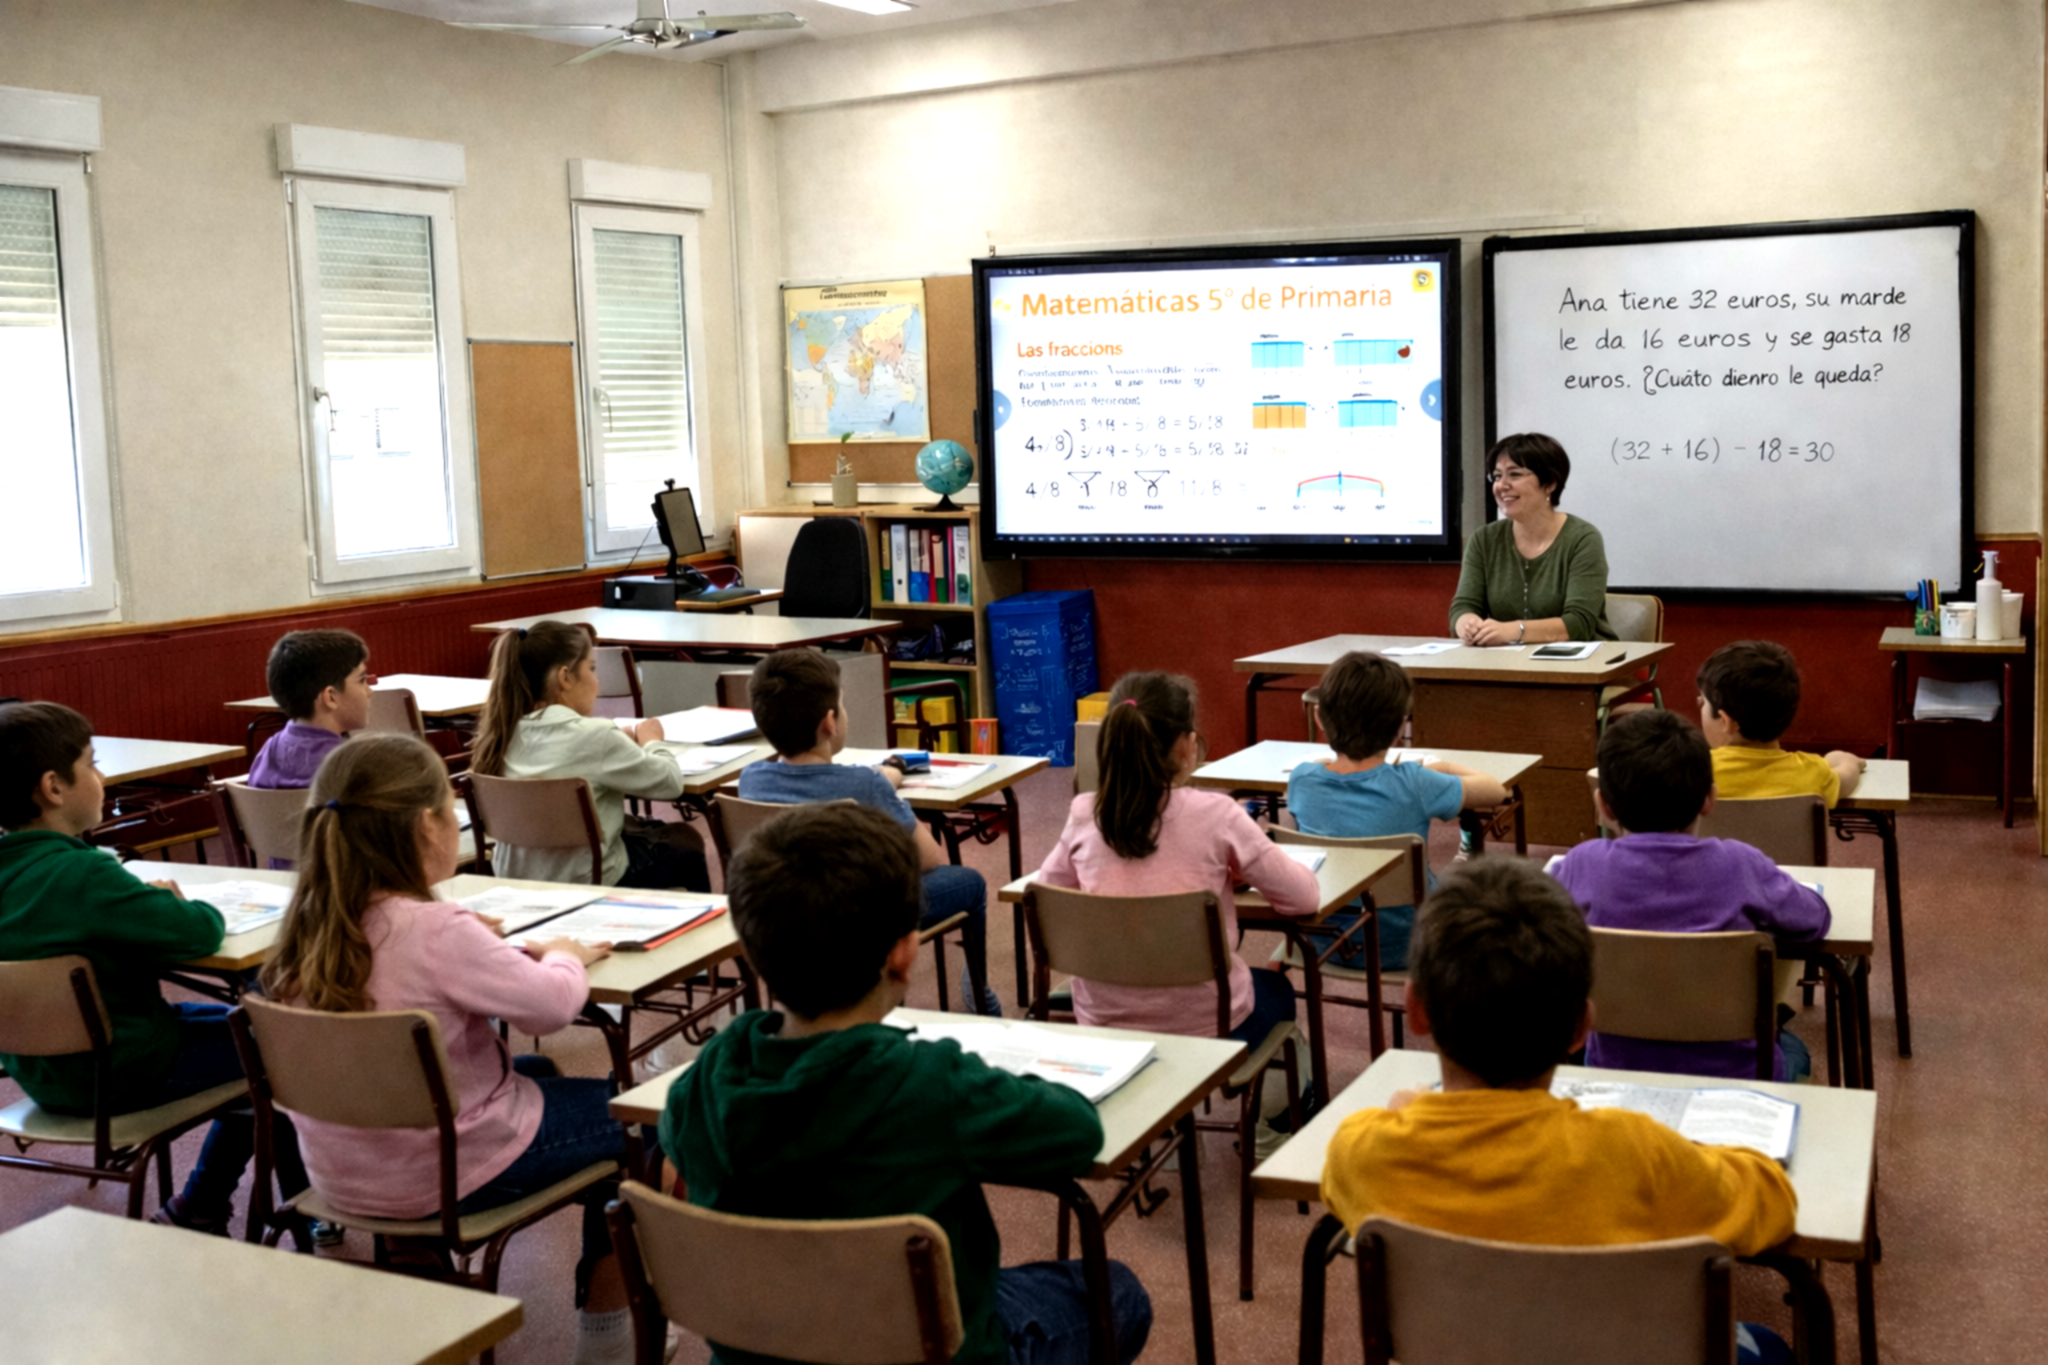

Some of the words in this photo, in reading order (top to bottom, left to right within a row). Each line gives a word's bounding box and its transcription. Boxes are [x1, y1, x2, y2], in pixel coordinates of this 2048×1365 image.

[1022, 288, 1200, 317] Matemáticas
[1241, 286, 1272, 311] de
[1281, 284, 1392, 309] Primaria
[1558, 286, 1608, 314] Ana
[1619, 287, 1680, 310] tiene
[1688, 289, 1718, 310] 32
[1727, 291, 1797, 311] euros,
[1805, 291, 1831, 308] su
[1840, 286, 1908, 307] marde
[1018, 342, 1044, 358] Las
[1048, 341, 1124, 358] fraccions
[1560, 327, 1579, 351] le
[1595, 327, 1626, 350] da
[1643, 327, 1664, 350] 16
[1677, 332, 1752, 350] euros
[1765, 332, 1778, 353] y
[1790, 330, 1814, 347] se
[1822, 325, 1883, 352] gasta
[1892, 322, 1912, 344] 18
[1564, 373, 1631, 390] euros.
[1721, 367, 1779, 388] dienro
[1789, 364, 1805, 385] le
[1814, 362, 1884, 390] queda?
[1611, 437, 1651, 465] (32
[1661, 443, 1673, 455] +
[1684, 437, 1721, 464] 16)
